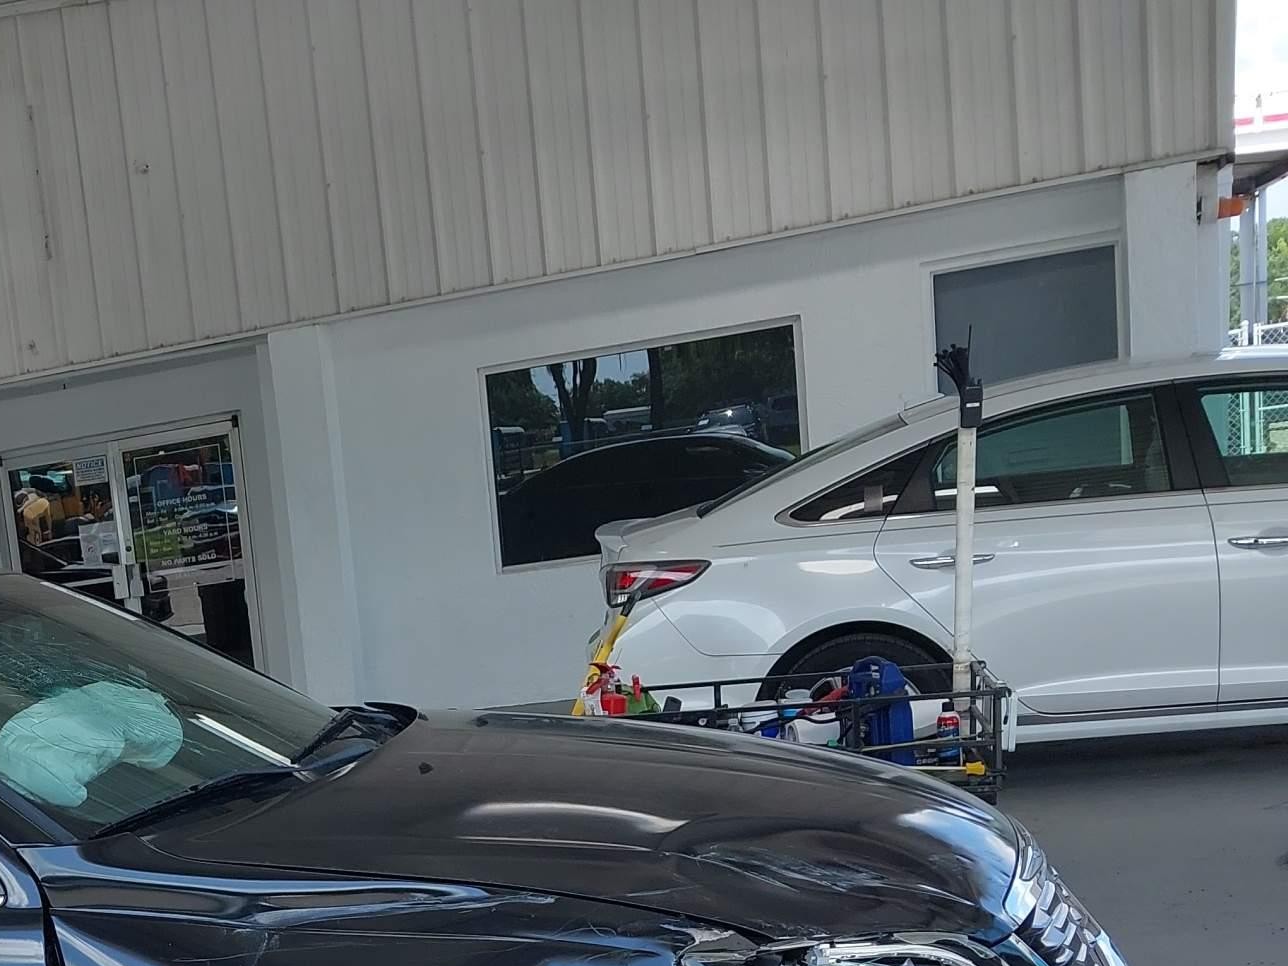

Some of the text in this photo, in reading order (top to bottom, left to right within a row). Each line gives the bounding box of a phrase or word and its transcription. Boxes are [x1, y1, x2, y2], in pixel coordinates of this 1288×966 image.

[76, 458, 104, 468] NOTICE
[157, 498, 181, 508] OFFICE
[182, 493, 208, 503] HOURS
[183, 523, 208, 534] HOURS
[161, 559, 172, 567] NO
[198, 552, 217, 562] SOLD
